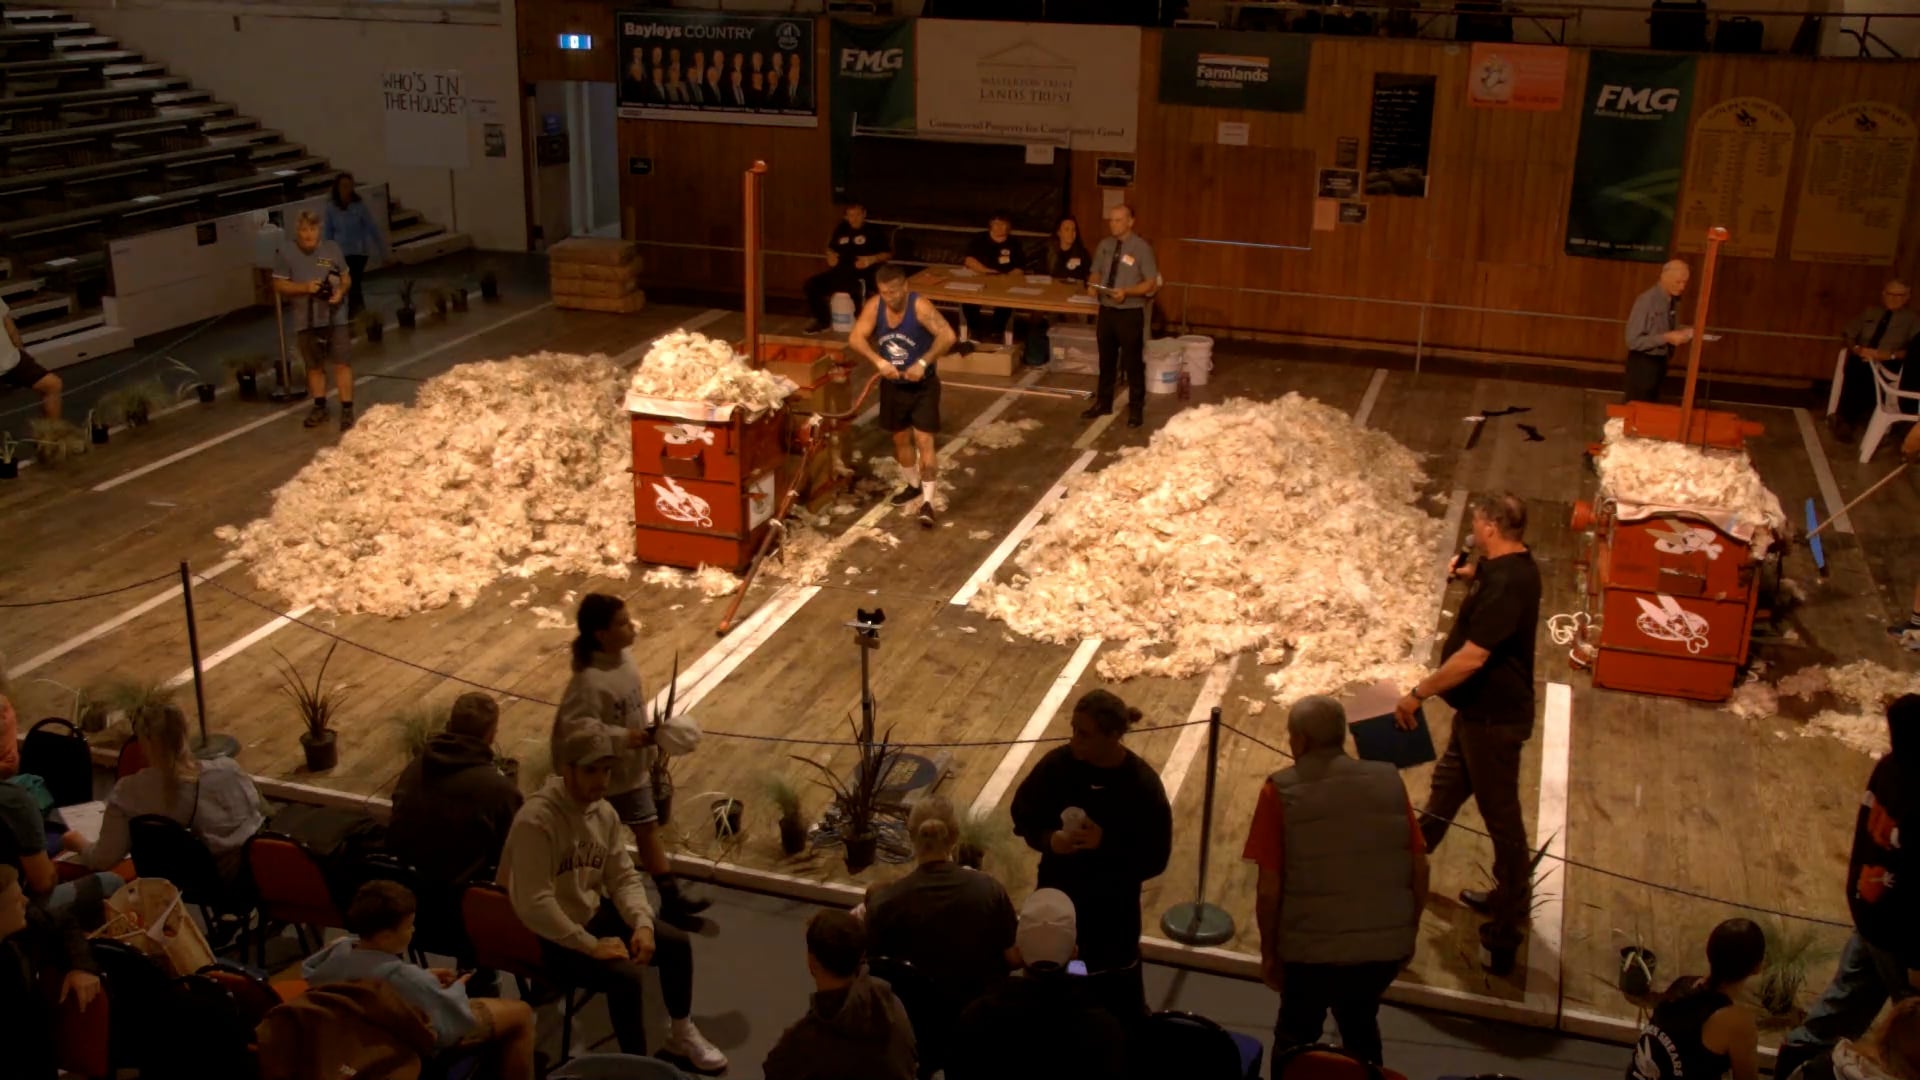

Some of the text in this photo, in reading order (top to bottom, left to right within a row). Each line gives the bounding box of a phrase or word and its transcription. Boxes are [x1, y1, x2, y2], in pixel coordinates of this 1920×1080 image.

[623, 21, 756, 41] Bayleys COUNTRY
[840, 47, 904, 72] FMG
[383, 72, 459, 96] WHO'S IN
[1196, 64, 1269, 83] Farmlands
[383, 92, 407, 111] THE
[1596, 84, 1680, 113] FMG
